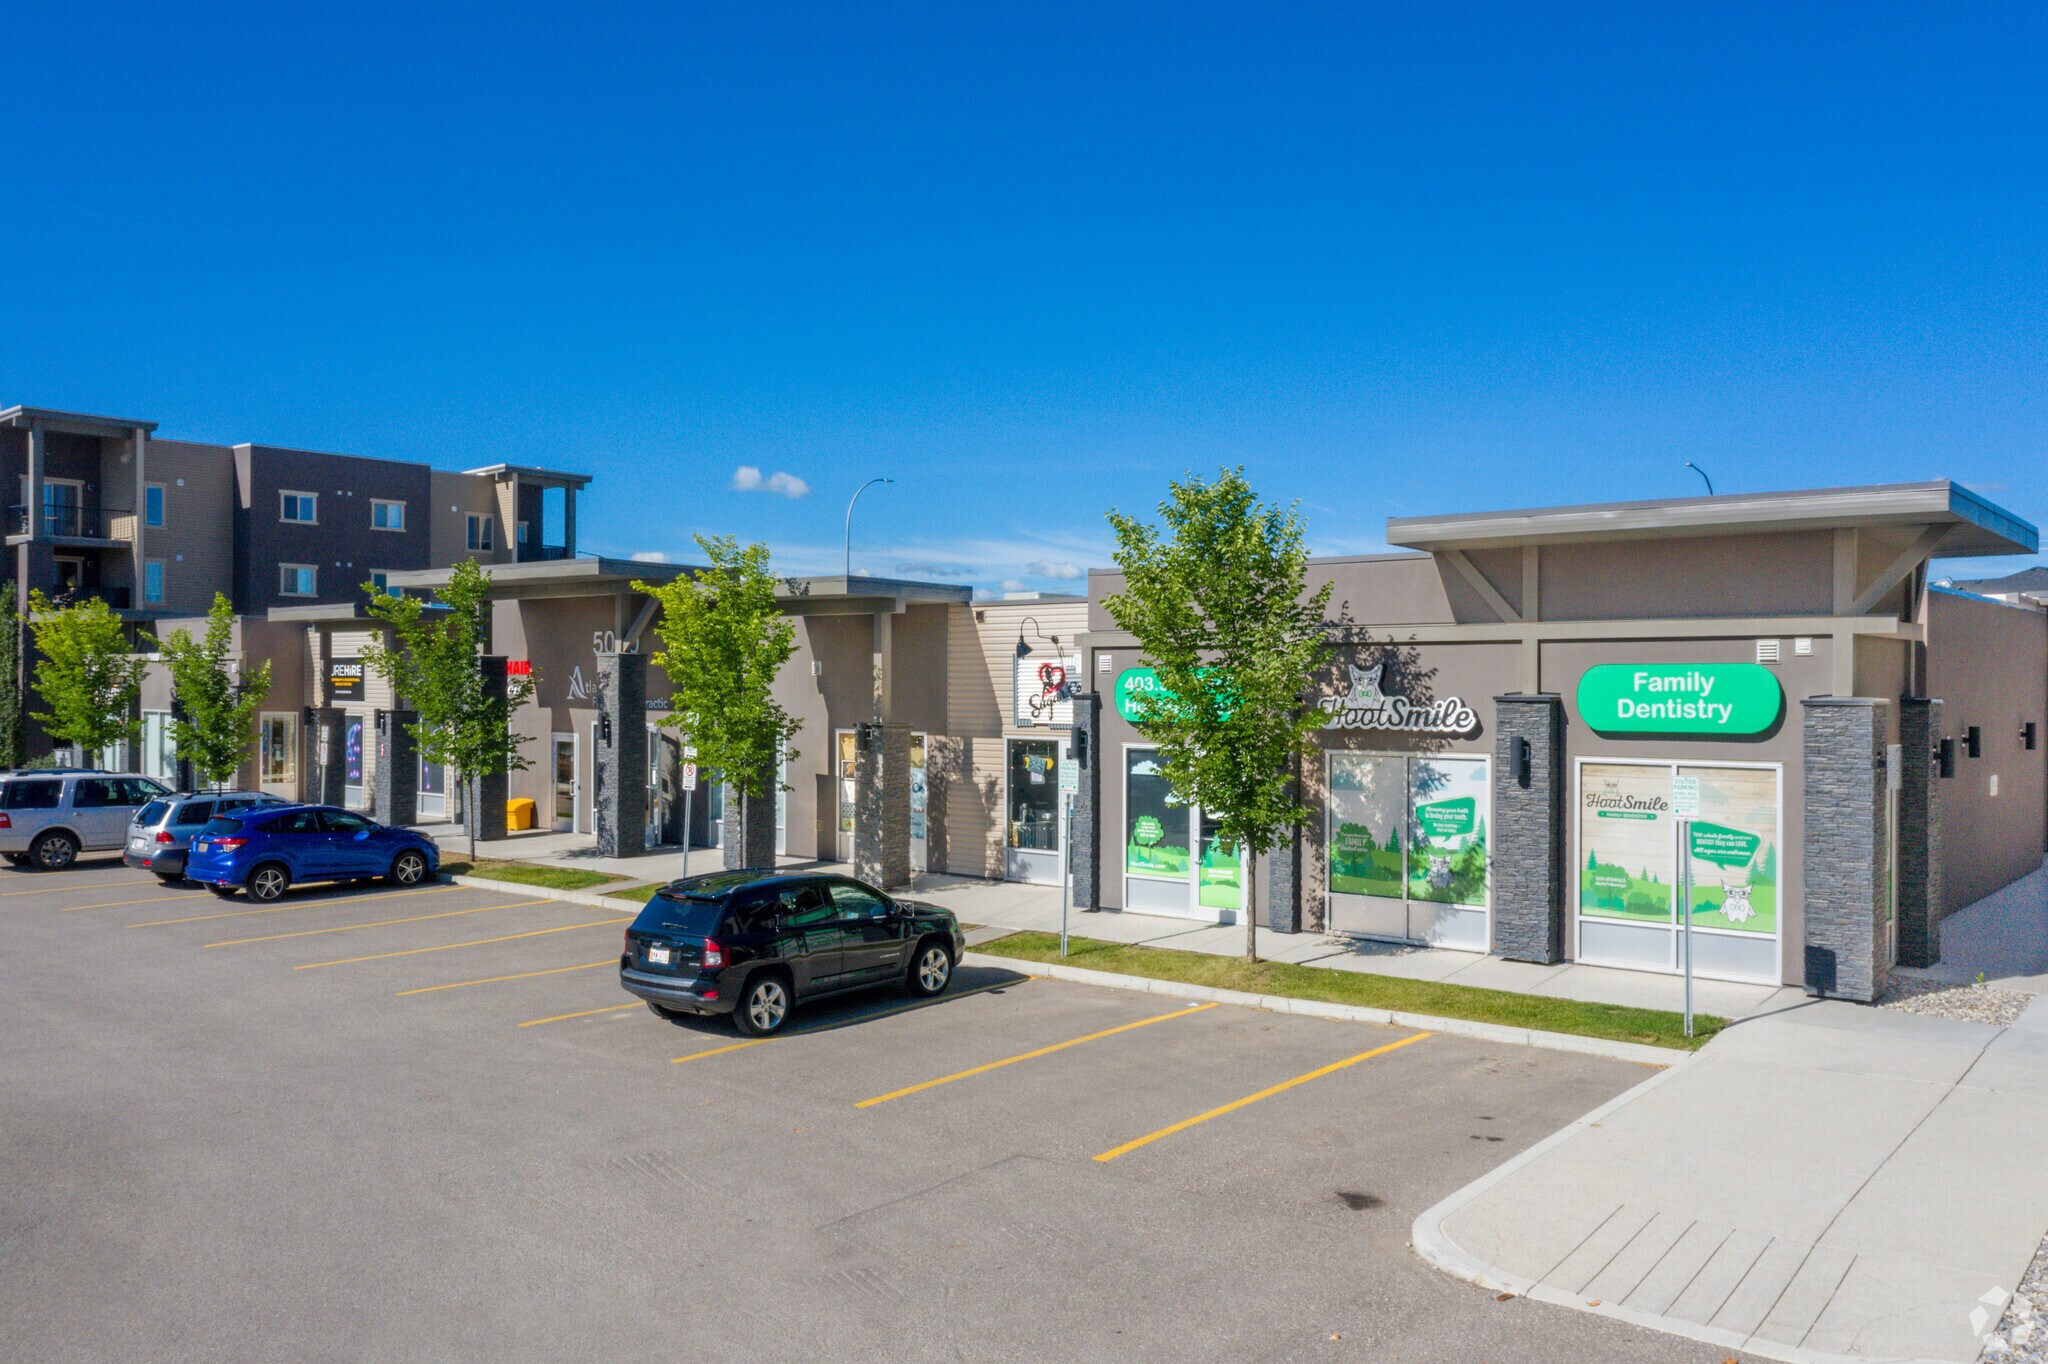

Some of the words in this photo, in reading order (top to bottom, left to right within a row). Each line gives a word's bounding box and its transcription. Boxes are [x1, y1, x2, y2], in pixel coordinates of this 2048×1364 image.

[1633, 671, 1715, 697] Family
[1319, 697, 1473, 728] HootSmile
[1617, 698, 1733, 724] Dentistry
[1586, 793, 1669, 811] HootSmile
[1345, 837, 1368, 847] FAMILY
[1715, 839, 1726, 847] they
